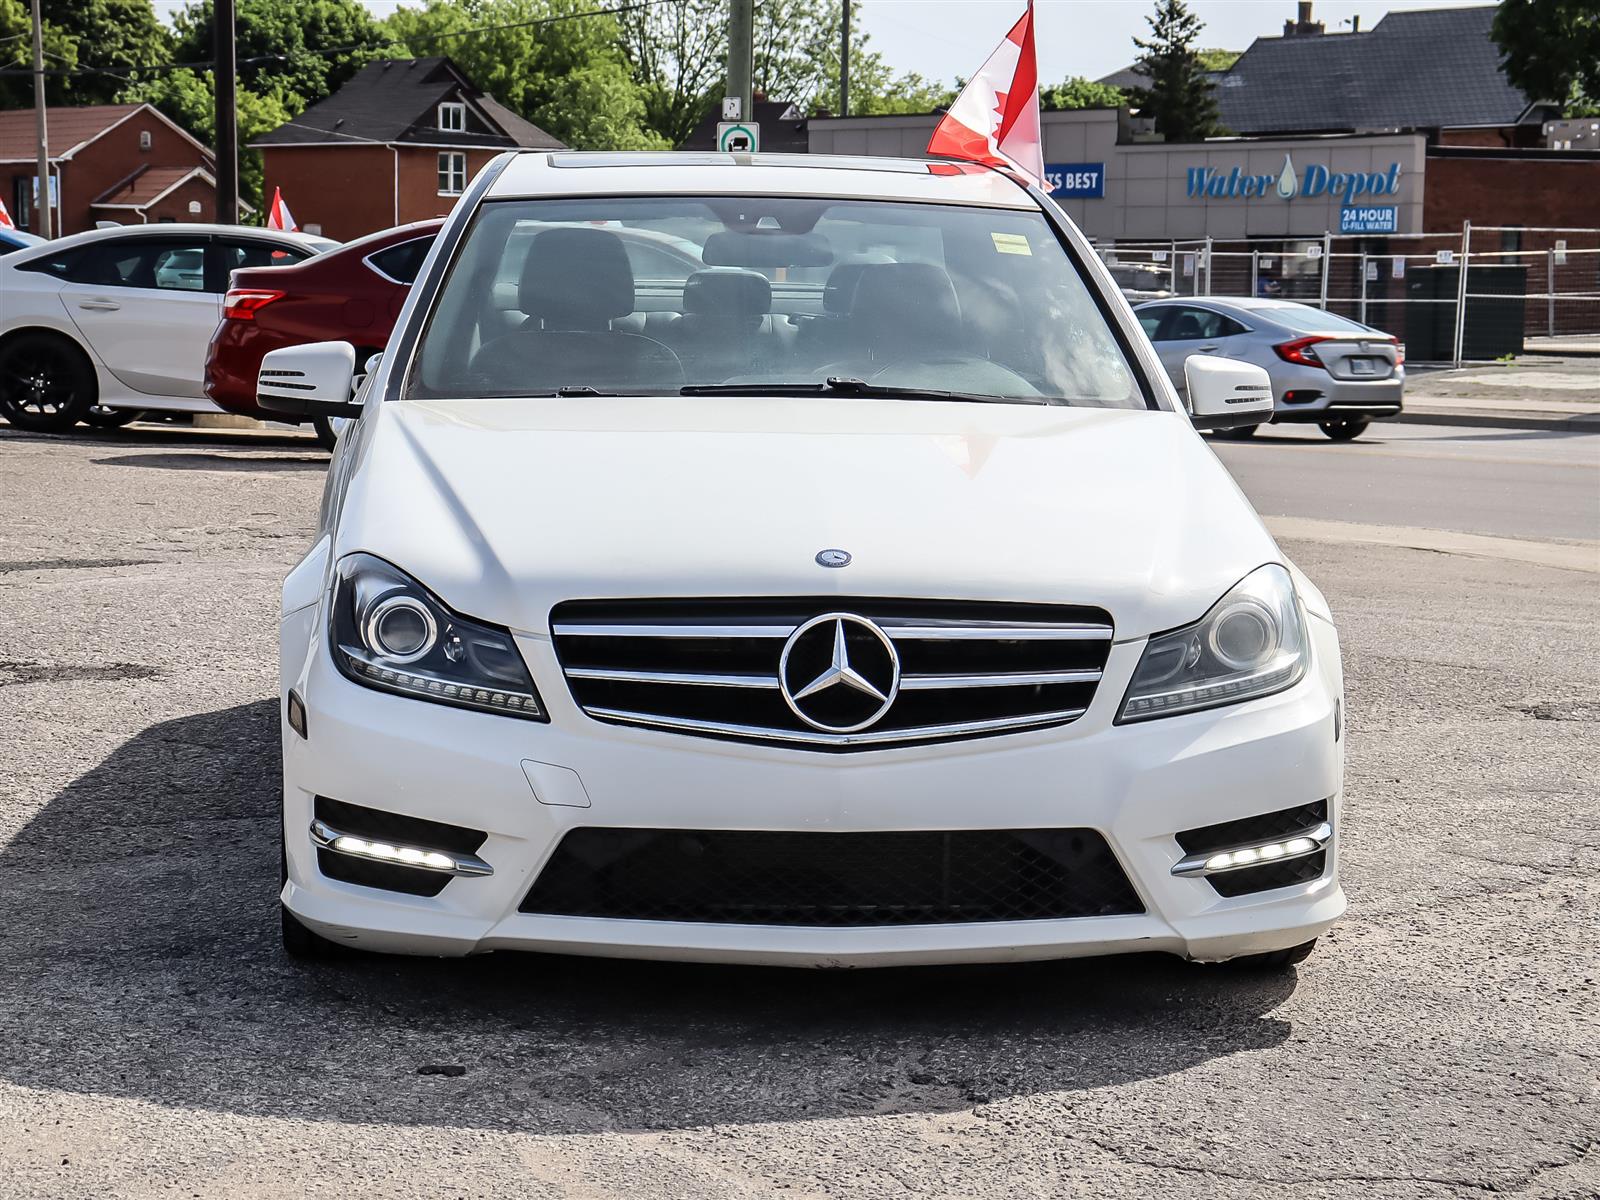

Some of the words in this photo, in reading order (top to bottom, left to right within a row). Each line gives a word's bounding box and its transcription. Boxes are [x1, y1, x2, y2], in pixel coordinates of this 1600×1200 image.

[1066, 172, 1098, 190] BEST
[1187, 166, 1275, 199] Water
[1301, 162, 1401, 206] Depot
[1342, 209, 1357, 222] 24
[1359, 209, 1393, 222] HOUR
[1342, 221, 1365, 231] U-FILL
[1366, 221, 1393, 230] WATER
